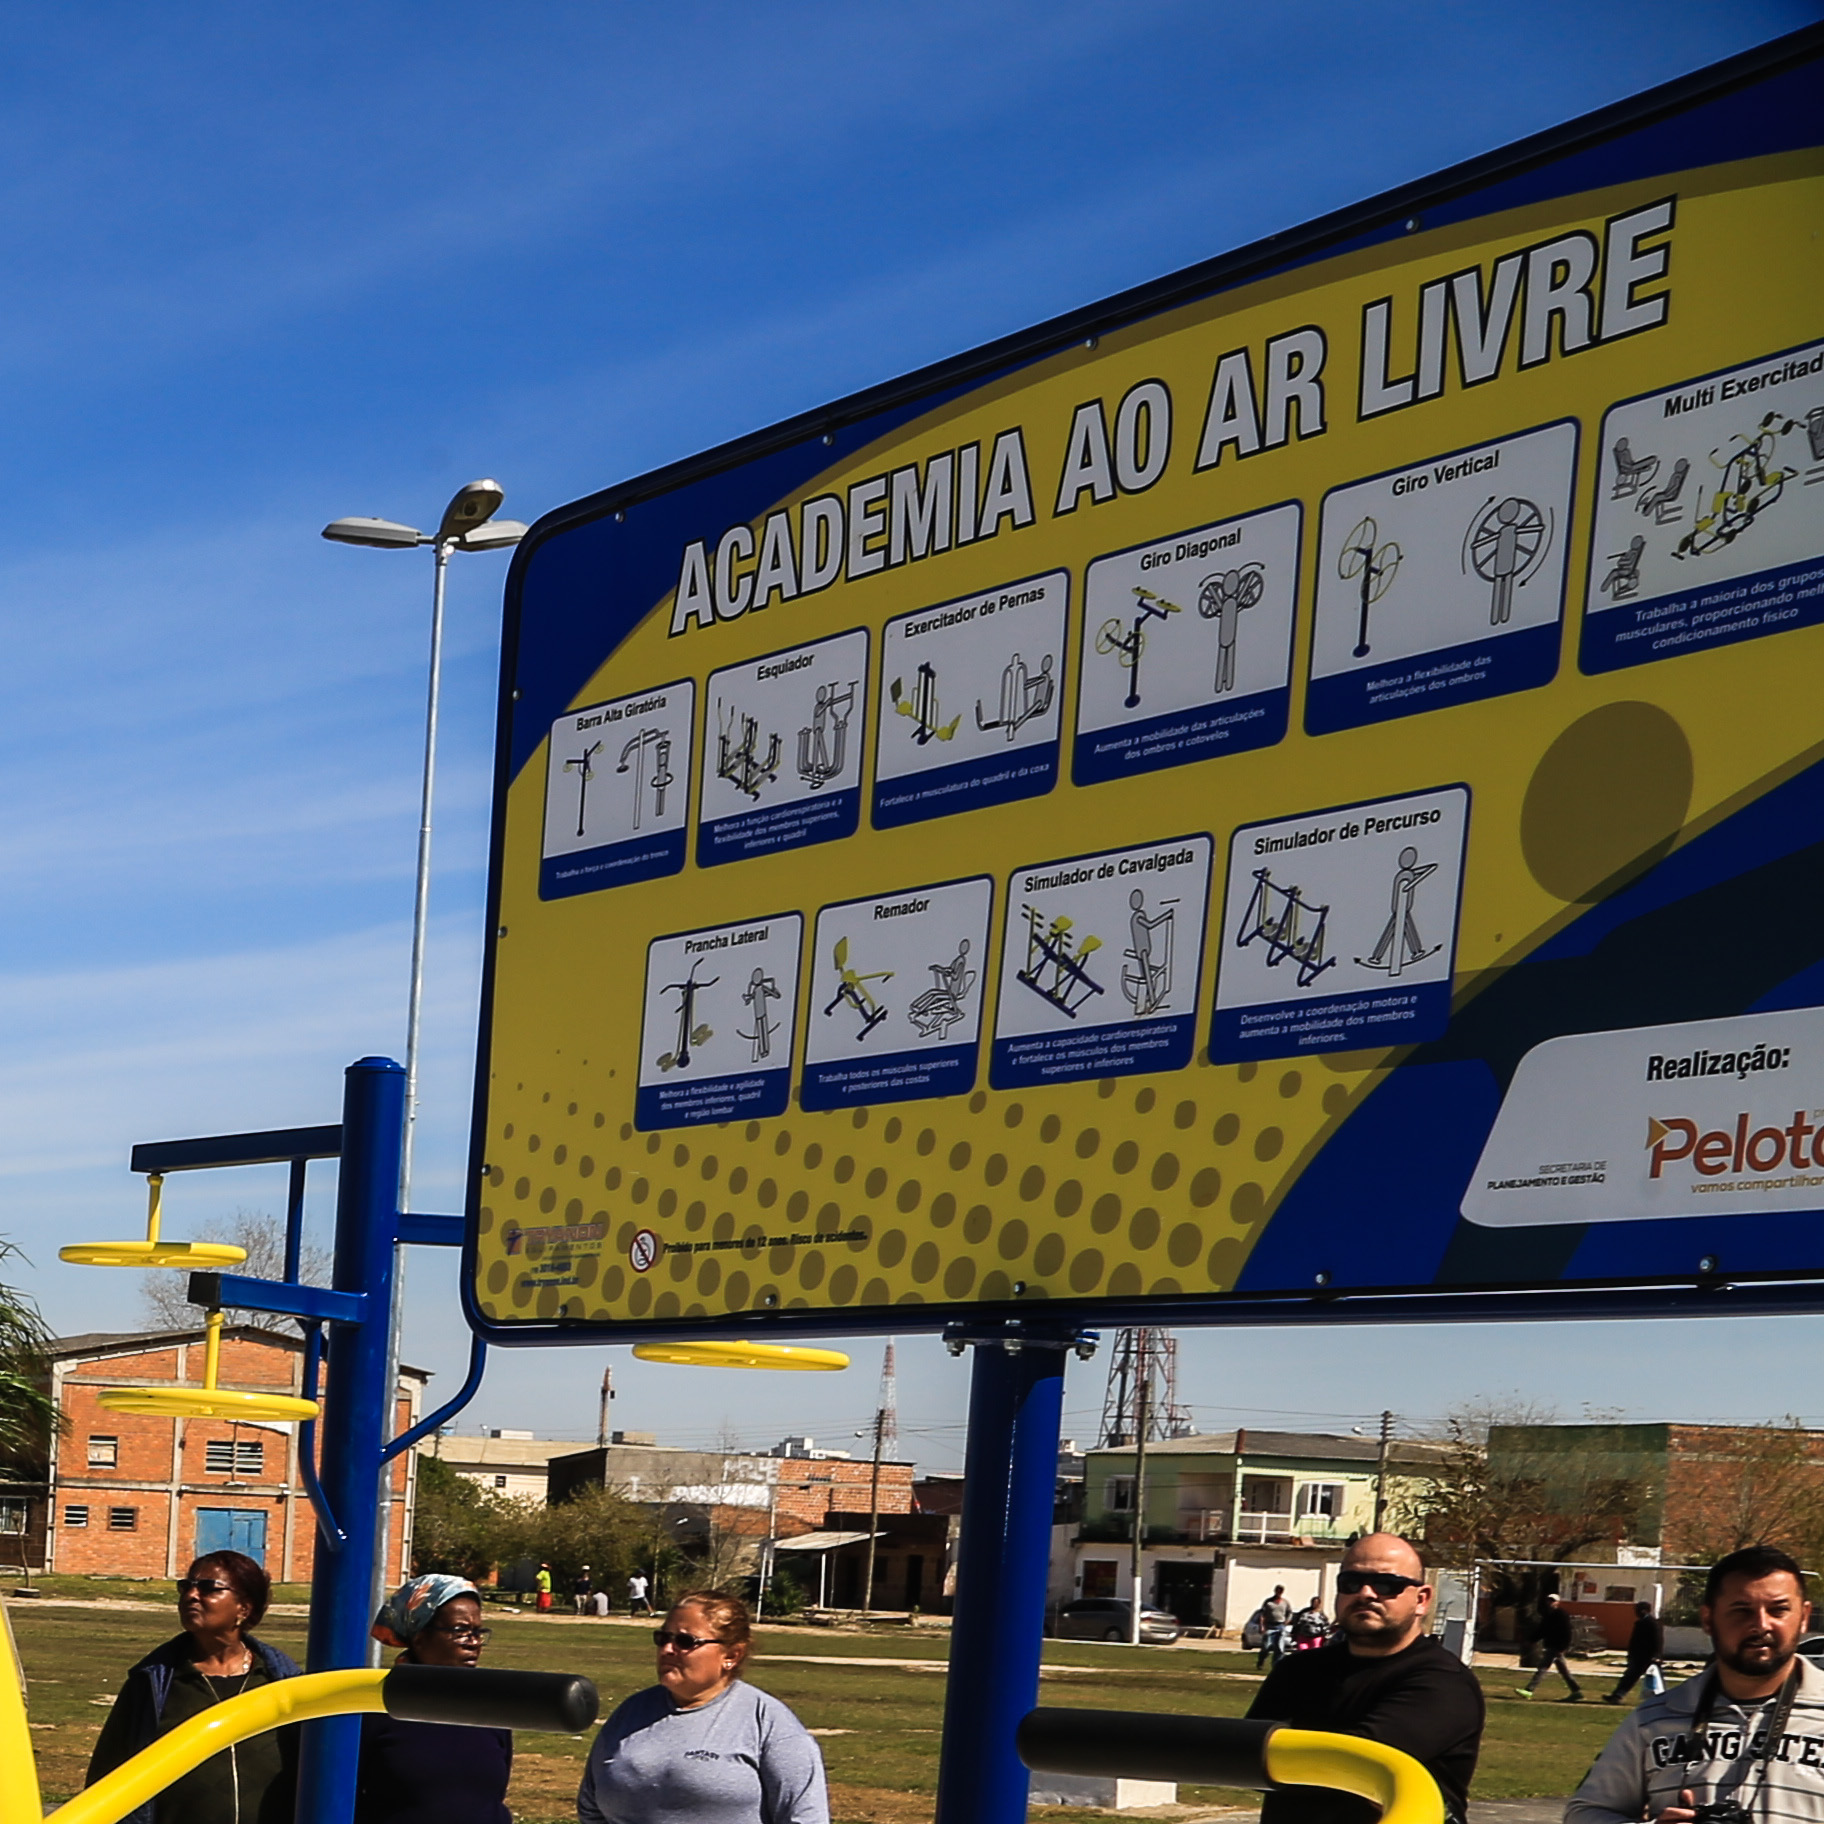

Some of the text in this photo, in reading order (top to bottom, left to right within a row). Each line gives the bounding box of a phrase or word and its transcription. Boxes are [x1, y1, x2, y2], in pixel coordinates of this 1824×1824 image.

[668, 192, 1678, 639] ACADEMIA AO AR LIVRE
[1664, 386, 1714, 417] Multi
[1392, 450, 1499, 496] Giro Vertical
[1141, 528, 1241, 570] Giro Diagonal
[905, 588, 1044, 638] Exercitador de Pernas
[1636, 603, 1687, 624] Trabalha
[1701, 588, 1747, 606] maioria
[1751, 582, 1774, 594] dos
[1692, 593, 1793, 626] proporcionando
[1653, 618, 1759, 649] condicionamento
[757, 655, 814, 680] Esquiador
[1367, 677, 1403, 691] Melhora
[1414, 661, 1471, 680] flexibilidade
[1474, 657, 1491, 666] das
[1370, 671, 1486, 703] articulações dos ombros
[577, 696, 666, 731] Barra Alta Giratória
[1094, 739, 1132, 753] Aumenta
[1141, 725, 1189, 742] mobilidade
[1191, 722, 1207, 731] das
[1210, 709, 1265, 727] articulações
[1125, 750, 1141, 759] dos
[1143, 742, 1176, 755] ombros
[1186, 730, 1229, 746] cotovelos
[880, 794, 916, 807] Fortalece
[922, 782, 971, 797] musculatura
[970, 779, 980, 787] do
[982, 771, 1010, 785] quadril
[1018, 768, 1028, 776] da
[1030, 764, 1049, 773] coxa
[1254, 810, 1441, 855] Simulador de Percurso
[1025, 848, 1193, 892] Simulador de Cavalgada
[874, 898, 930, 920] Remador
[685, 926, 768, 954] Prancha Lateral
[1239, 1026, 1279, 1038] aumenta
[1290, 1018, 1343, 1032] mobilidade
[1346, 1016, 1364, 1025] dos
[1367, 1010, 1414, 1022] membros
[1241, 1011, 1295, 1024] Desenvolve
[1306, 1001, 1370, 1016] coordenação
[1372, 997, 1408, 1008] motora
[1008, 1042, 1044, 1052] Aumenta
[1052, 1034, 1099, 1047] capacidade
[1019, 1054, 1054, 1063] fortalece
[1111, 1044, 1125, 1053] dos
[1124, 1039, 1169, 1051] membros
[1042, 1063, 1084, 1074] superiores
[1094, 1057, 1134, 1067] inferiores
[1646, 1043, 1790, 1080] Realização:
[1487, 1172, 1605, 1190] PLANEJAMENTO E GESTÃO
[1539, 1161, 1607, 1175] SECRETARIA DE
[1691, 1183, 1734, 1193] vamos
